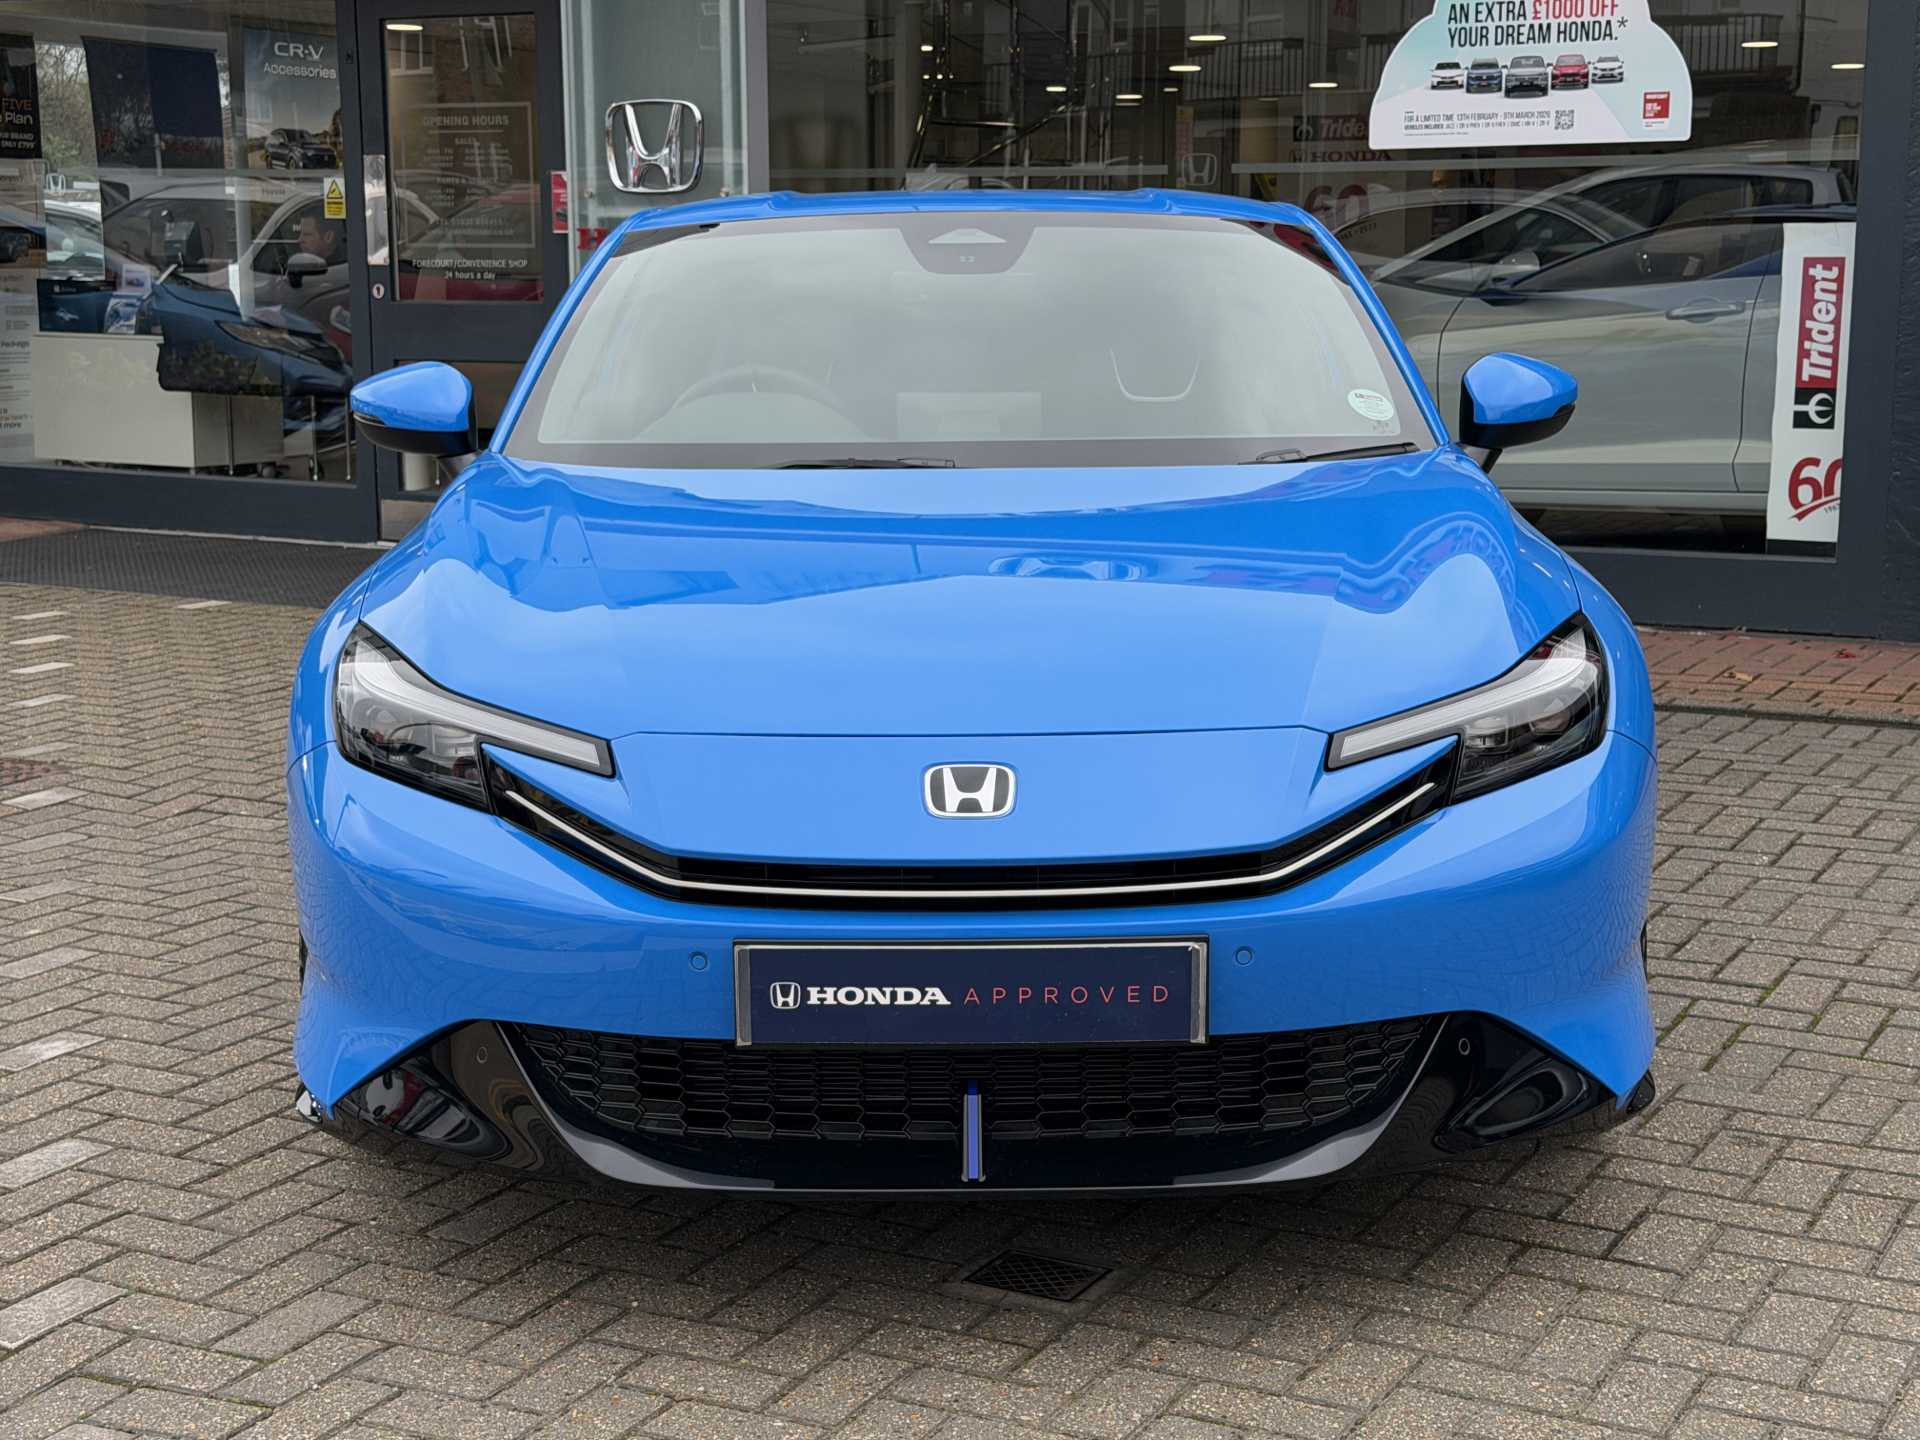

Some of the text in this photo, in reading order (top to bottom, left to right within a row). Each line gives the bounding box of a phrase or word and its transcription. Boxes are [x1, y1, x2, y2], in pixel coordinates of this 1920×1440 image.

[1448, 4, 1470, 25] AN
[1475, 1, 1527, 23] EXTRA
[1532, 0, 1585, 20] £1000
[1448, 26, 1489, 48] YOUR
[1494, 22, 1552, 46] DREAM
[263, 62, 337, 80] Accessories
[5, 111, 33, 125] Plan
[423, 114, 509, 126] OPENING HOURS
[1311, 150, 1393, 161] HONDA
[483, 271, 496, 281] day
[1801, 263, 1840, 382] Trident
[806, 986, 952, 1006] HONDA
[963, 985, 1169, 1005] APPROVED
